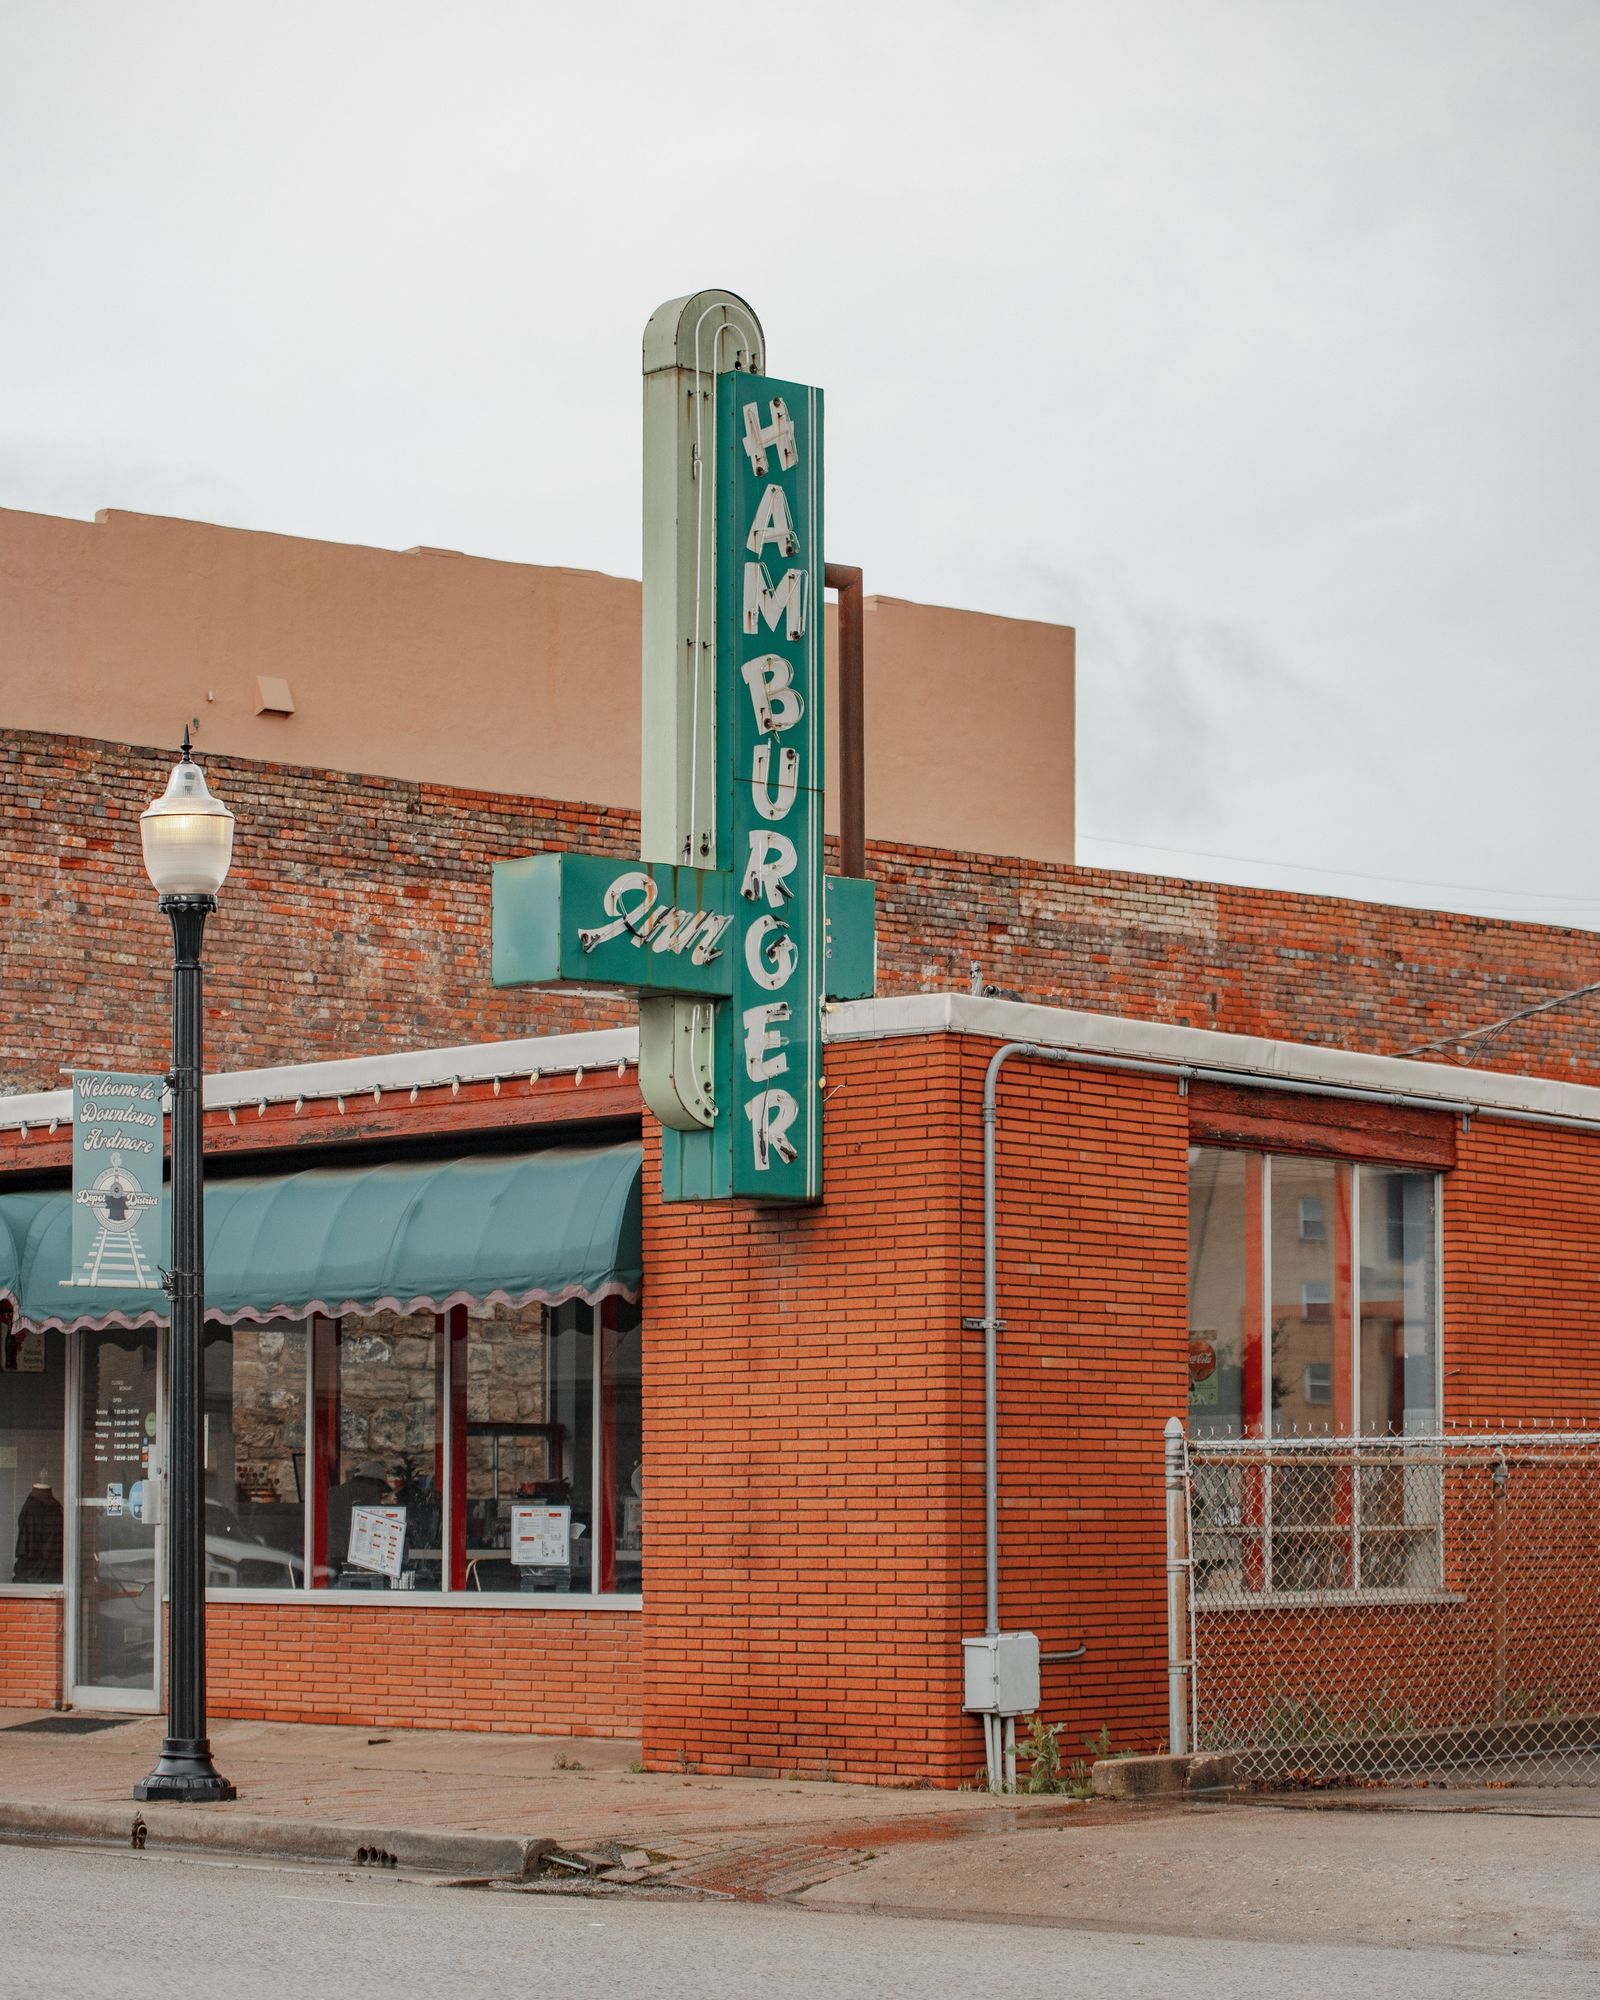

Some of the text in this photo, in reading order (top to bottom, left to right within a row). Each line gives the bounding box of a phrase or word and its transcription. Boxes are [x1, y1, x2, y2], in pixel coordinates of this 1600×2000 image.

[740, 397, 809, 1170] HAMBURGER
[578, 872, 734, 965] Inn
[77, 1076, 155, 1100] Welcome to
[80, 1102, 157, 1127] Downtown
[83, 1128, 154, 1153] Ardmore
[76, 1190, 106, 1206] Depot
[125, 1191, 159, 1207] District
